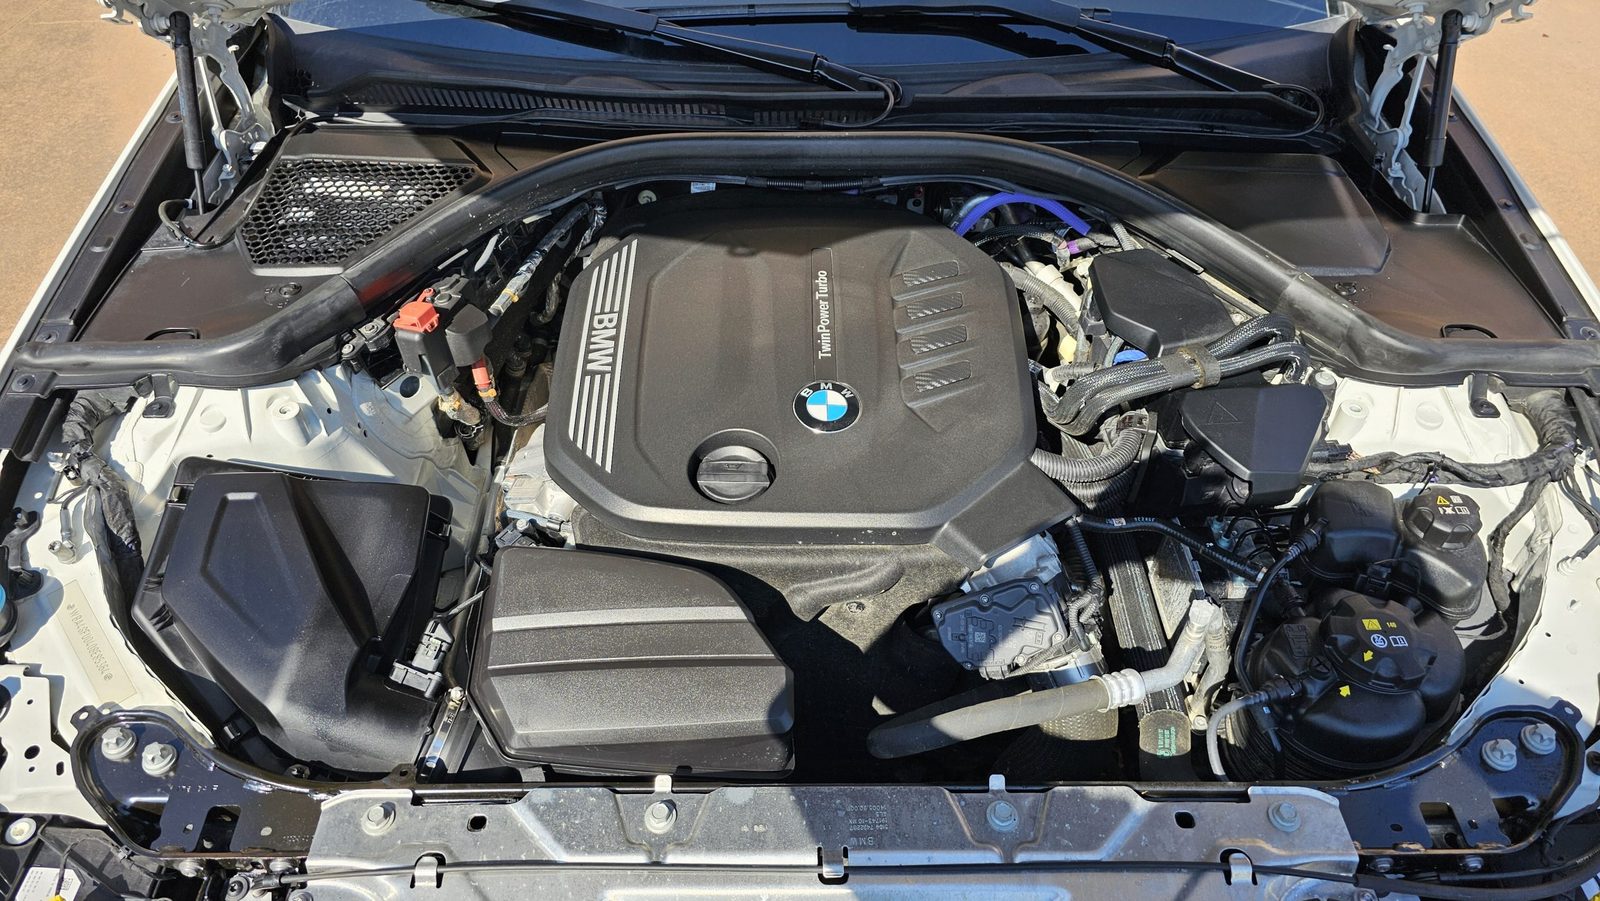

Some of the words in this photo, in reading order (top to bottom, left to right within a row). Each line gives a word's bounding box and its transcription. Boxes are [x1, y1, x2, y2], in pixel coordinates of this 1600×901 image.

[815, 270, 829, 299] Turbo
[586, 312, 619, 371] BMW
[817, 300, 832, 359] TwinPower
[800, 382, 854, 398] BMW
